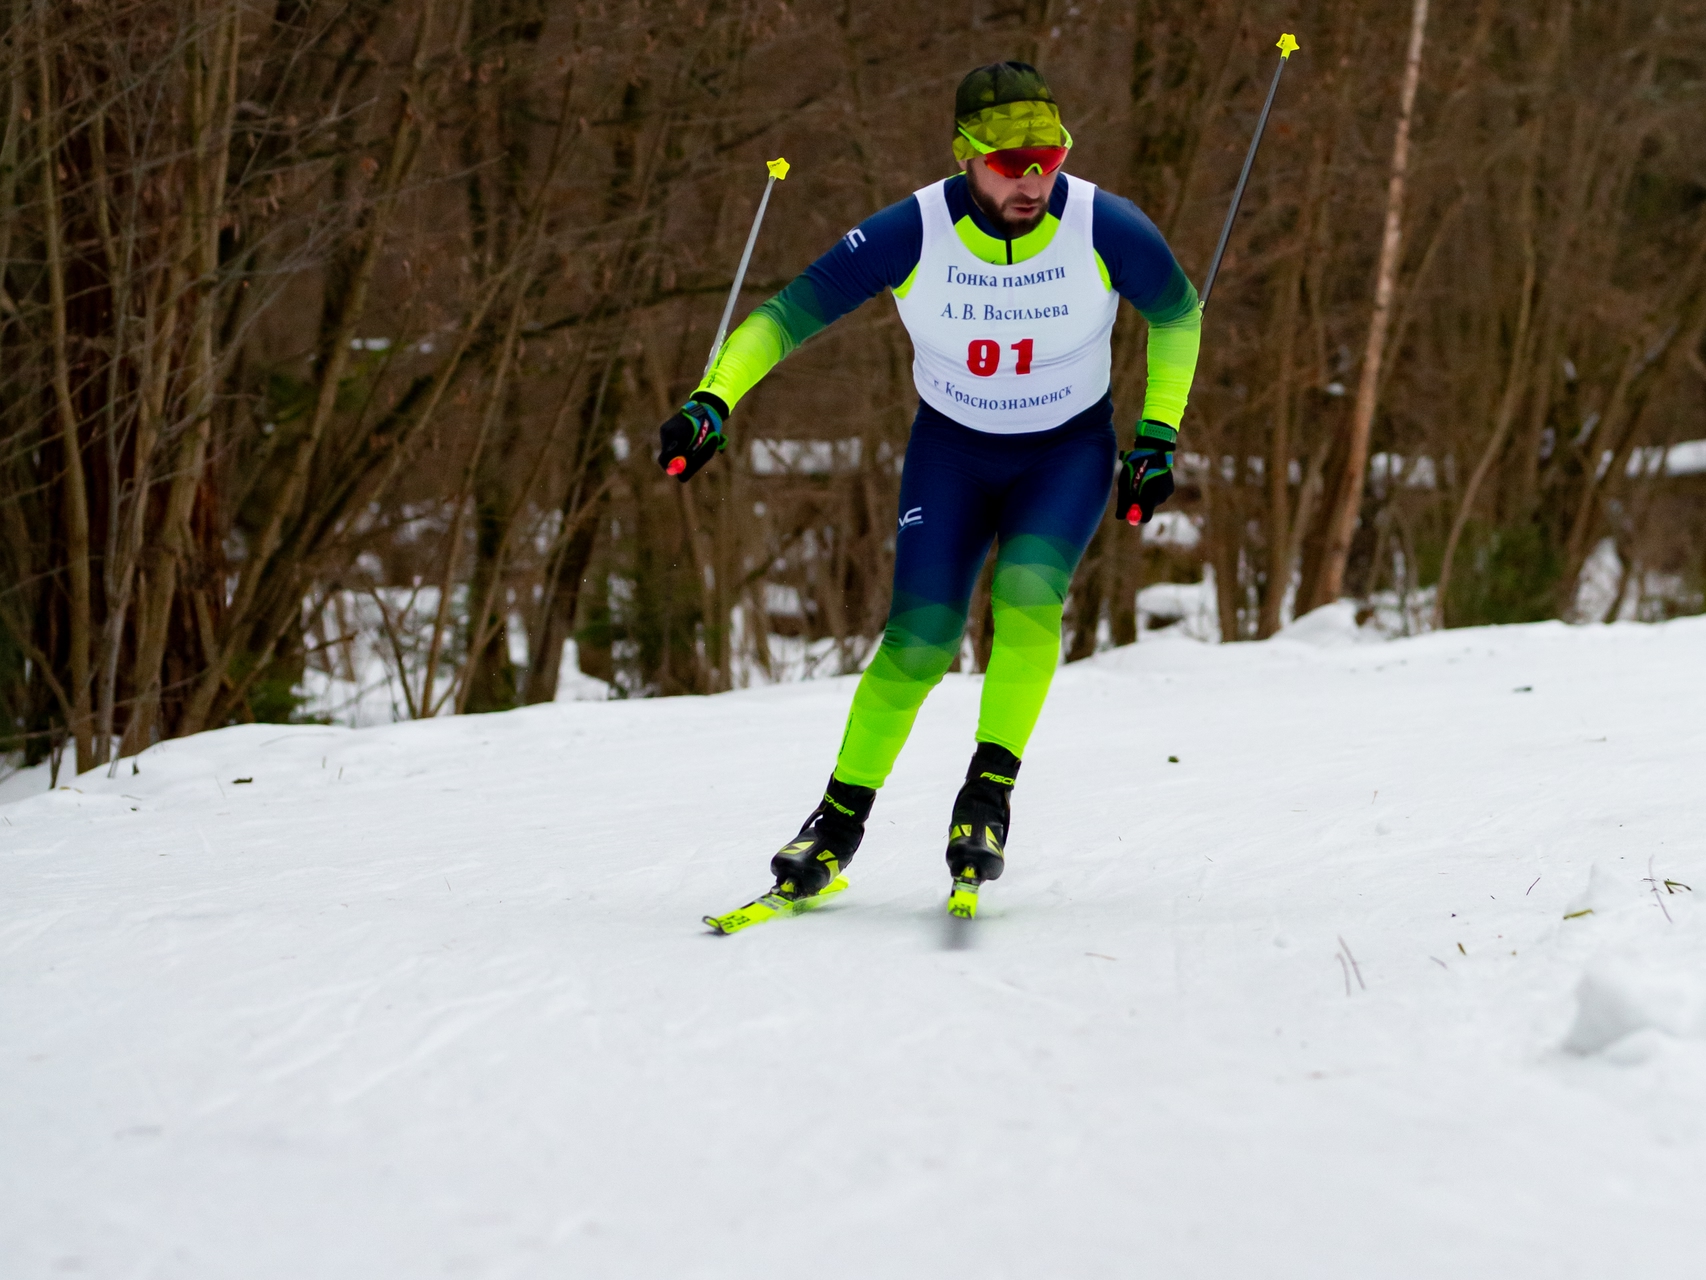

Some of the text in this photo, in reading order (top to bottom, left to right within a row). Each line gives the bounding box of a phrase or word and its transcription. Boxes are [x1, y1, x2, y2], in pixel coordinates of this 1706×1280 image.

[946, 265, 1066, 288] Гонка памяти
[940, 302, 1069, 321] А. В. Васильева
[945, 381, 1073, 411] Краснознаменск
